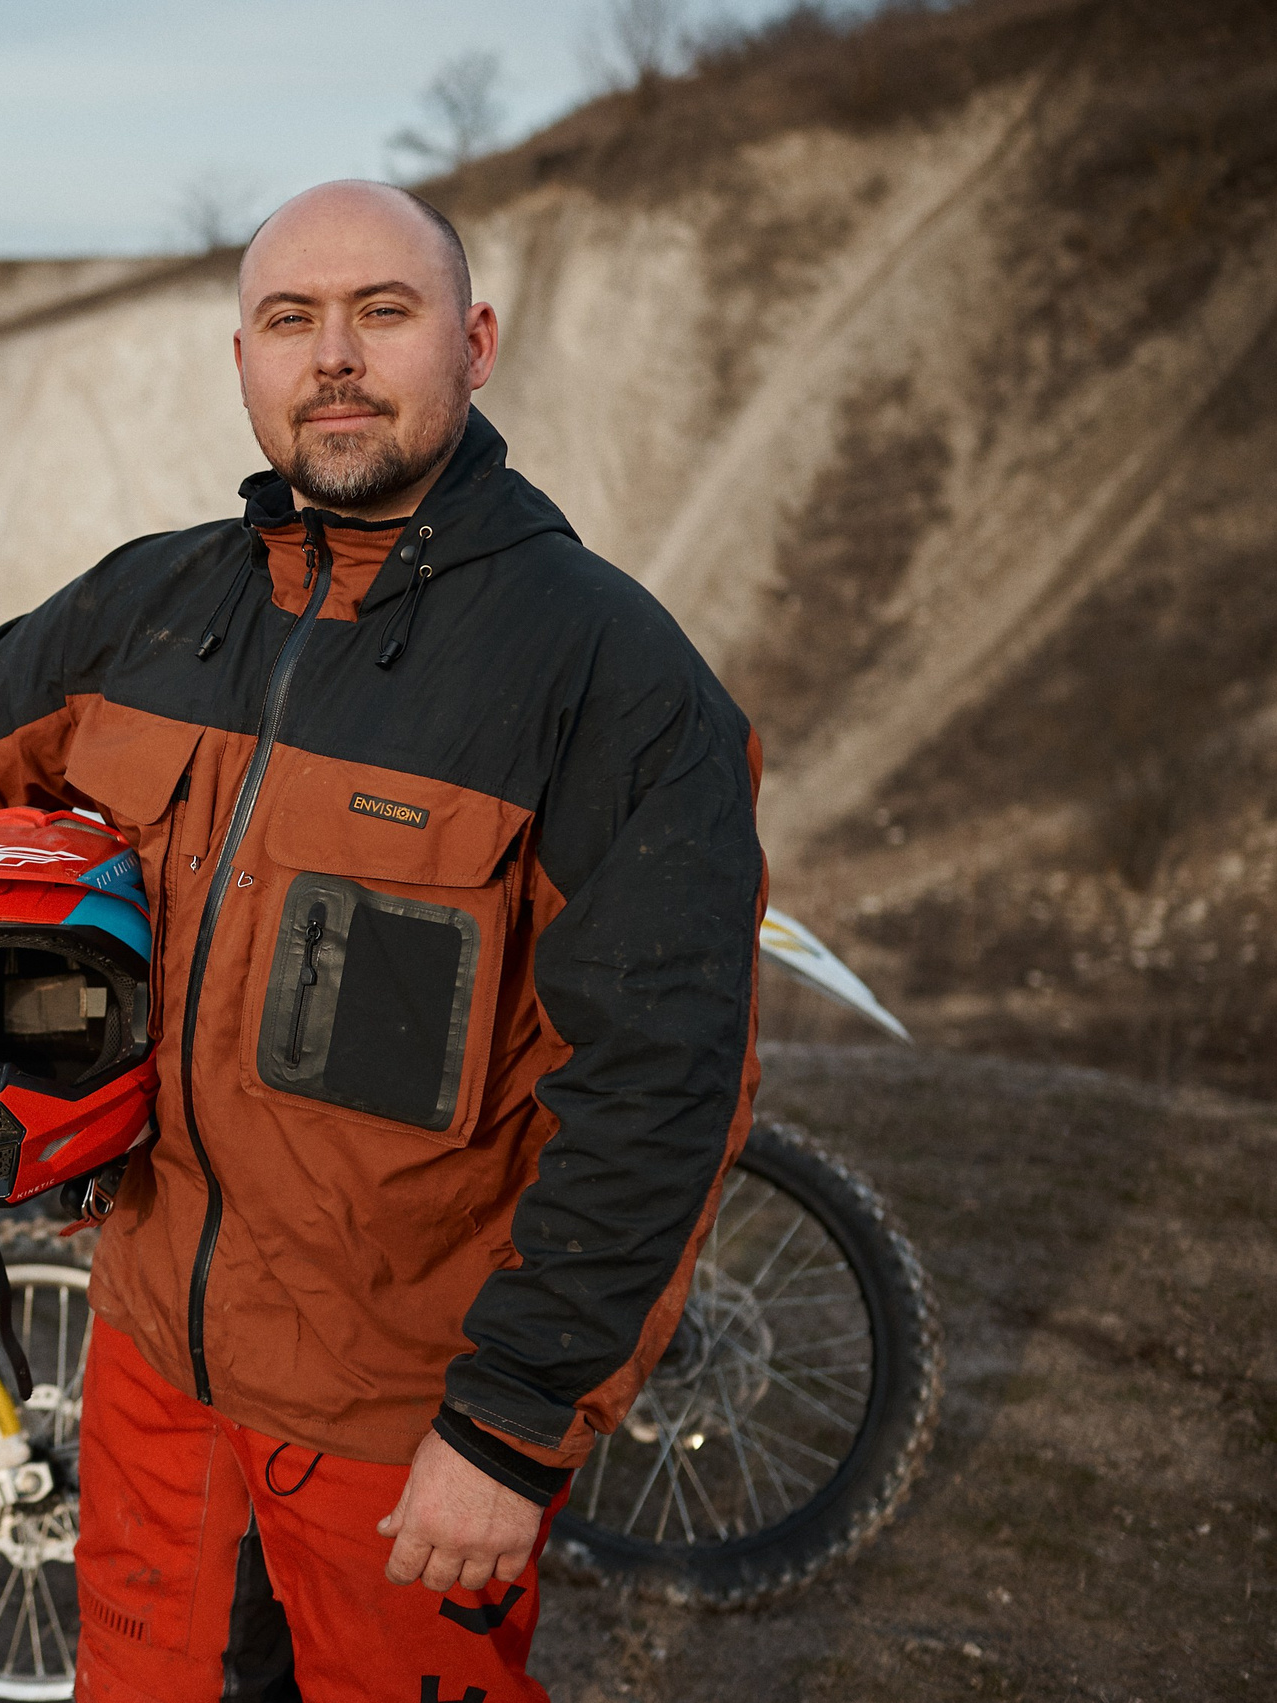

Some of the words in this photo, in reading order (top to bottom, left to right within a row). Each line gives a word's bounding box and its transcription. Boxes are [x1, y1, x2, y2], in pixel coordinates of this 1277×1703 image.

[353, 796, 422, 824] ENVISION
[96, 870, 112, 890] FLY
[16, 1178, 55, 1200] KINETIC
